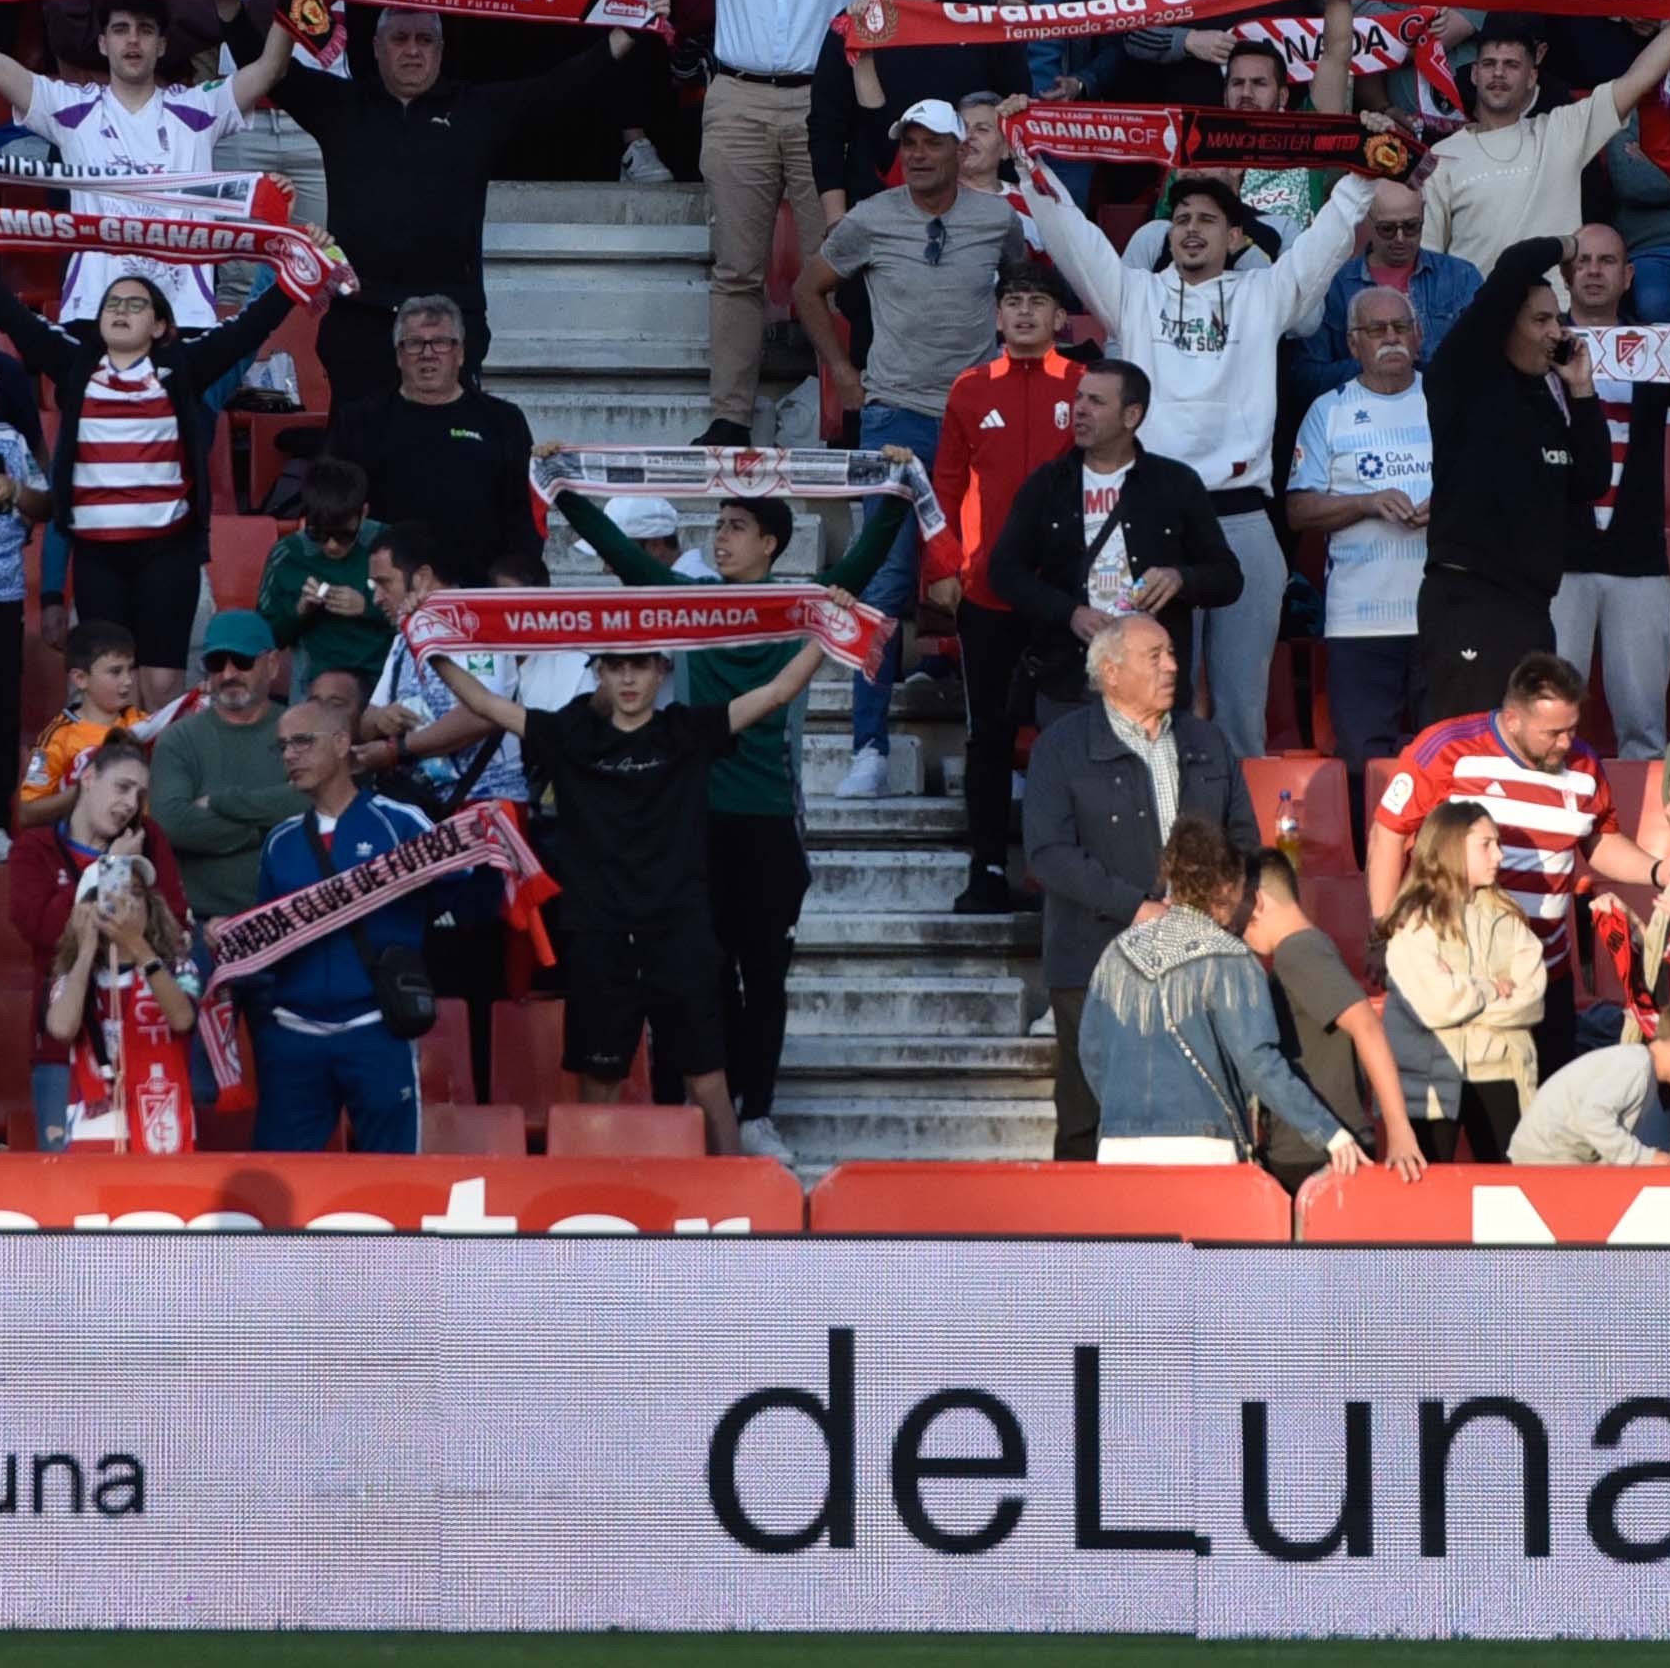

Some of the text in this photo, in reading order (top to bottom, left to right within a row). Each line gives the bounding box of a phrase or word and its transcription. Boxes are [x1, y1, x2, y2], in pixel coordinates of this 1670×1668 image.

[1003, 7, 1194, 41] Temporada 2024-2025
[1207, 132, 1360, 151] MANCHESTER UNITED
[98, 216, 256, 252] GRANADA
[505, 607, 759, 632] VAMOS MI GRANADA
[294, 880, 353, 926] CLUB
[356, 865, 384, 896] DE
